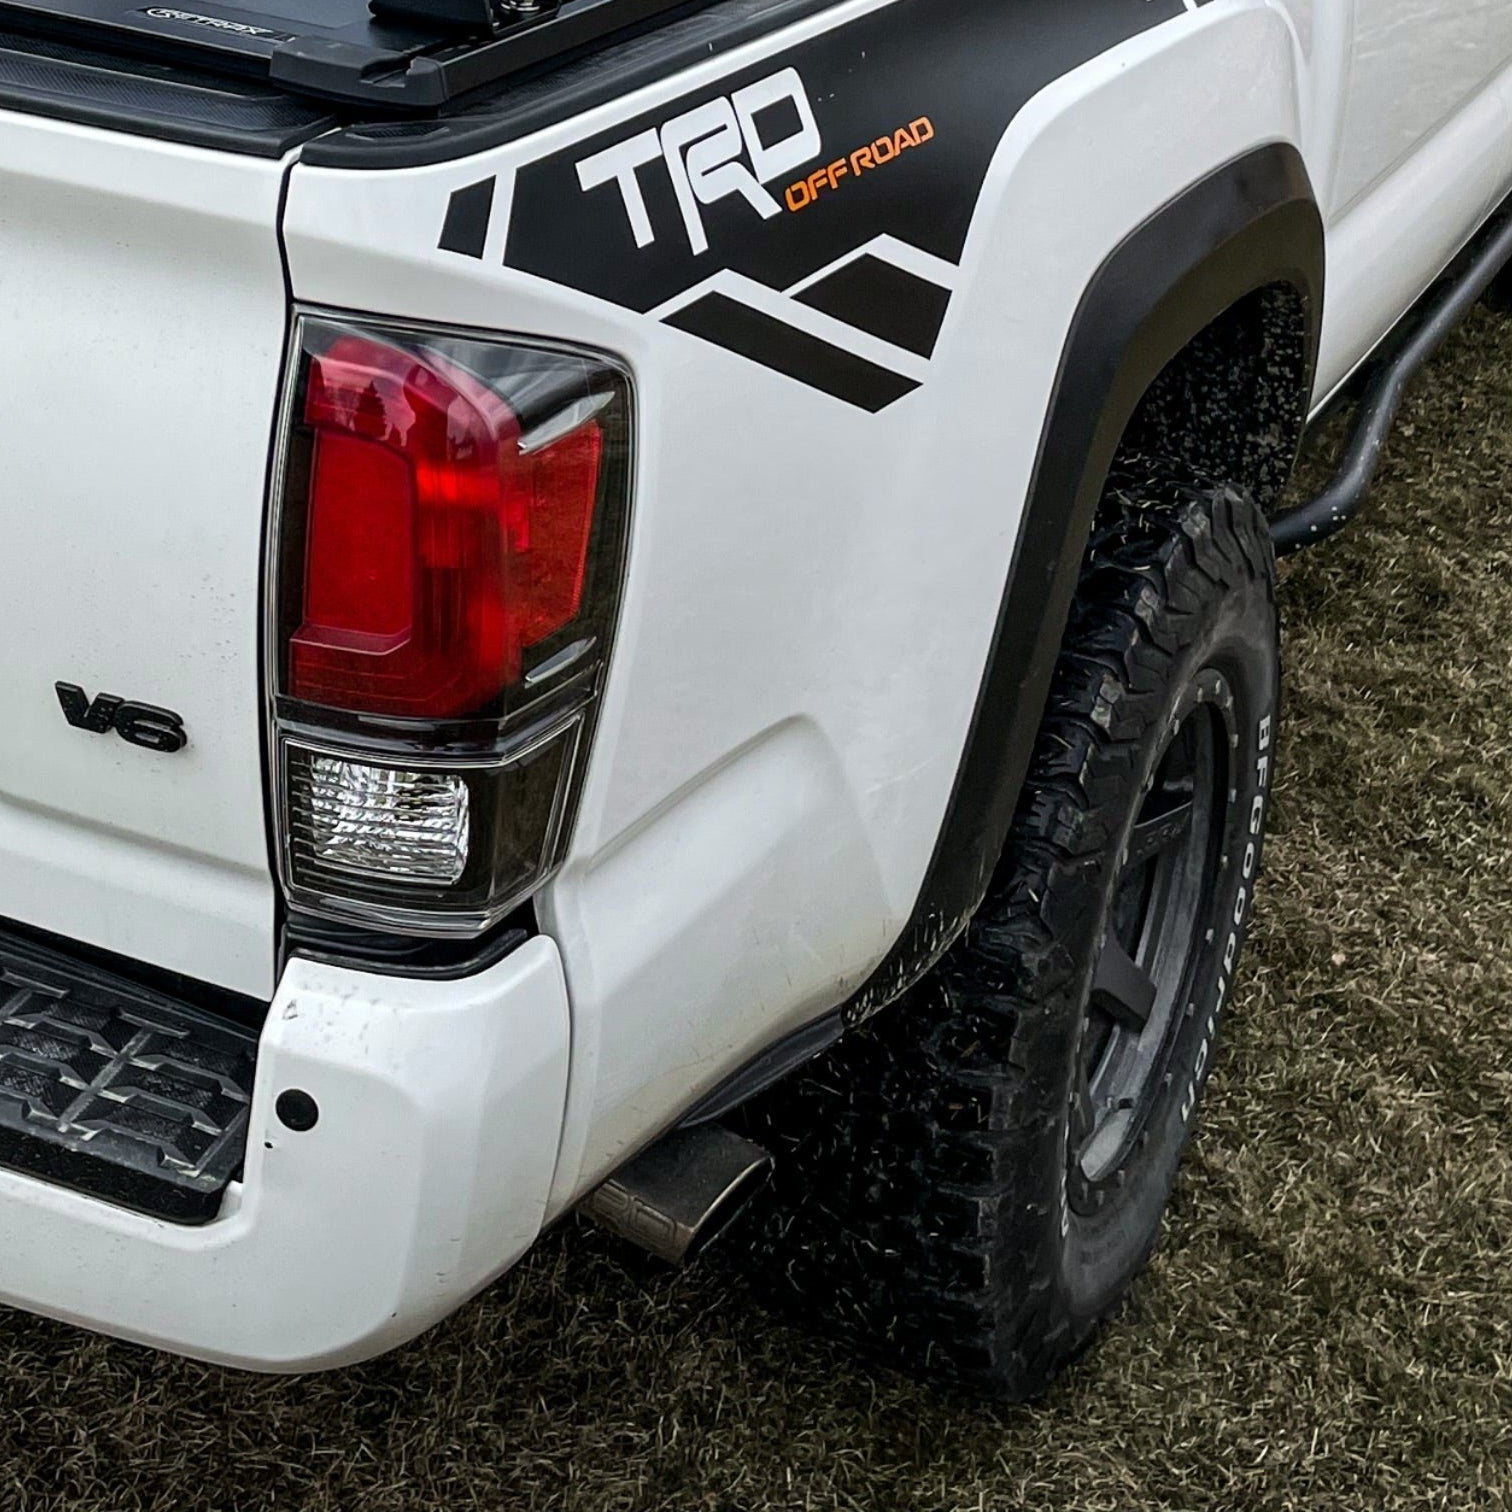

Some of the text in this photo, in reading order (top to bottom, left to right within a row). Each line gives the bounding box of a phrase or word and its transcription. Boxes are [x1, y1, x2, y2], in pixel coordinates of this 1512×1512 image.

[576, 67, 822, 256] TRD
[785, 118, 934, 212] OFF ROAD
[55, 681, 187, 753] V6
